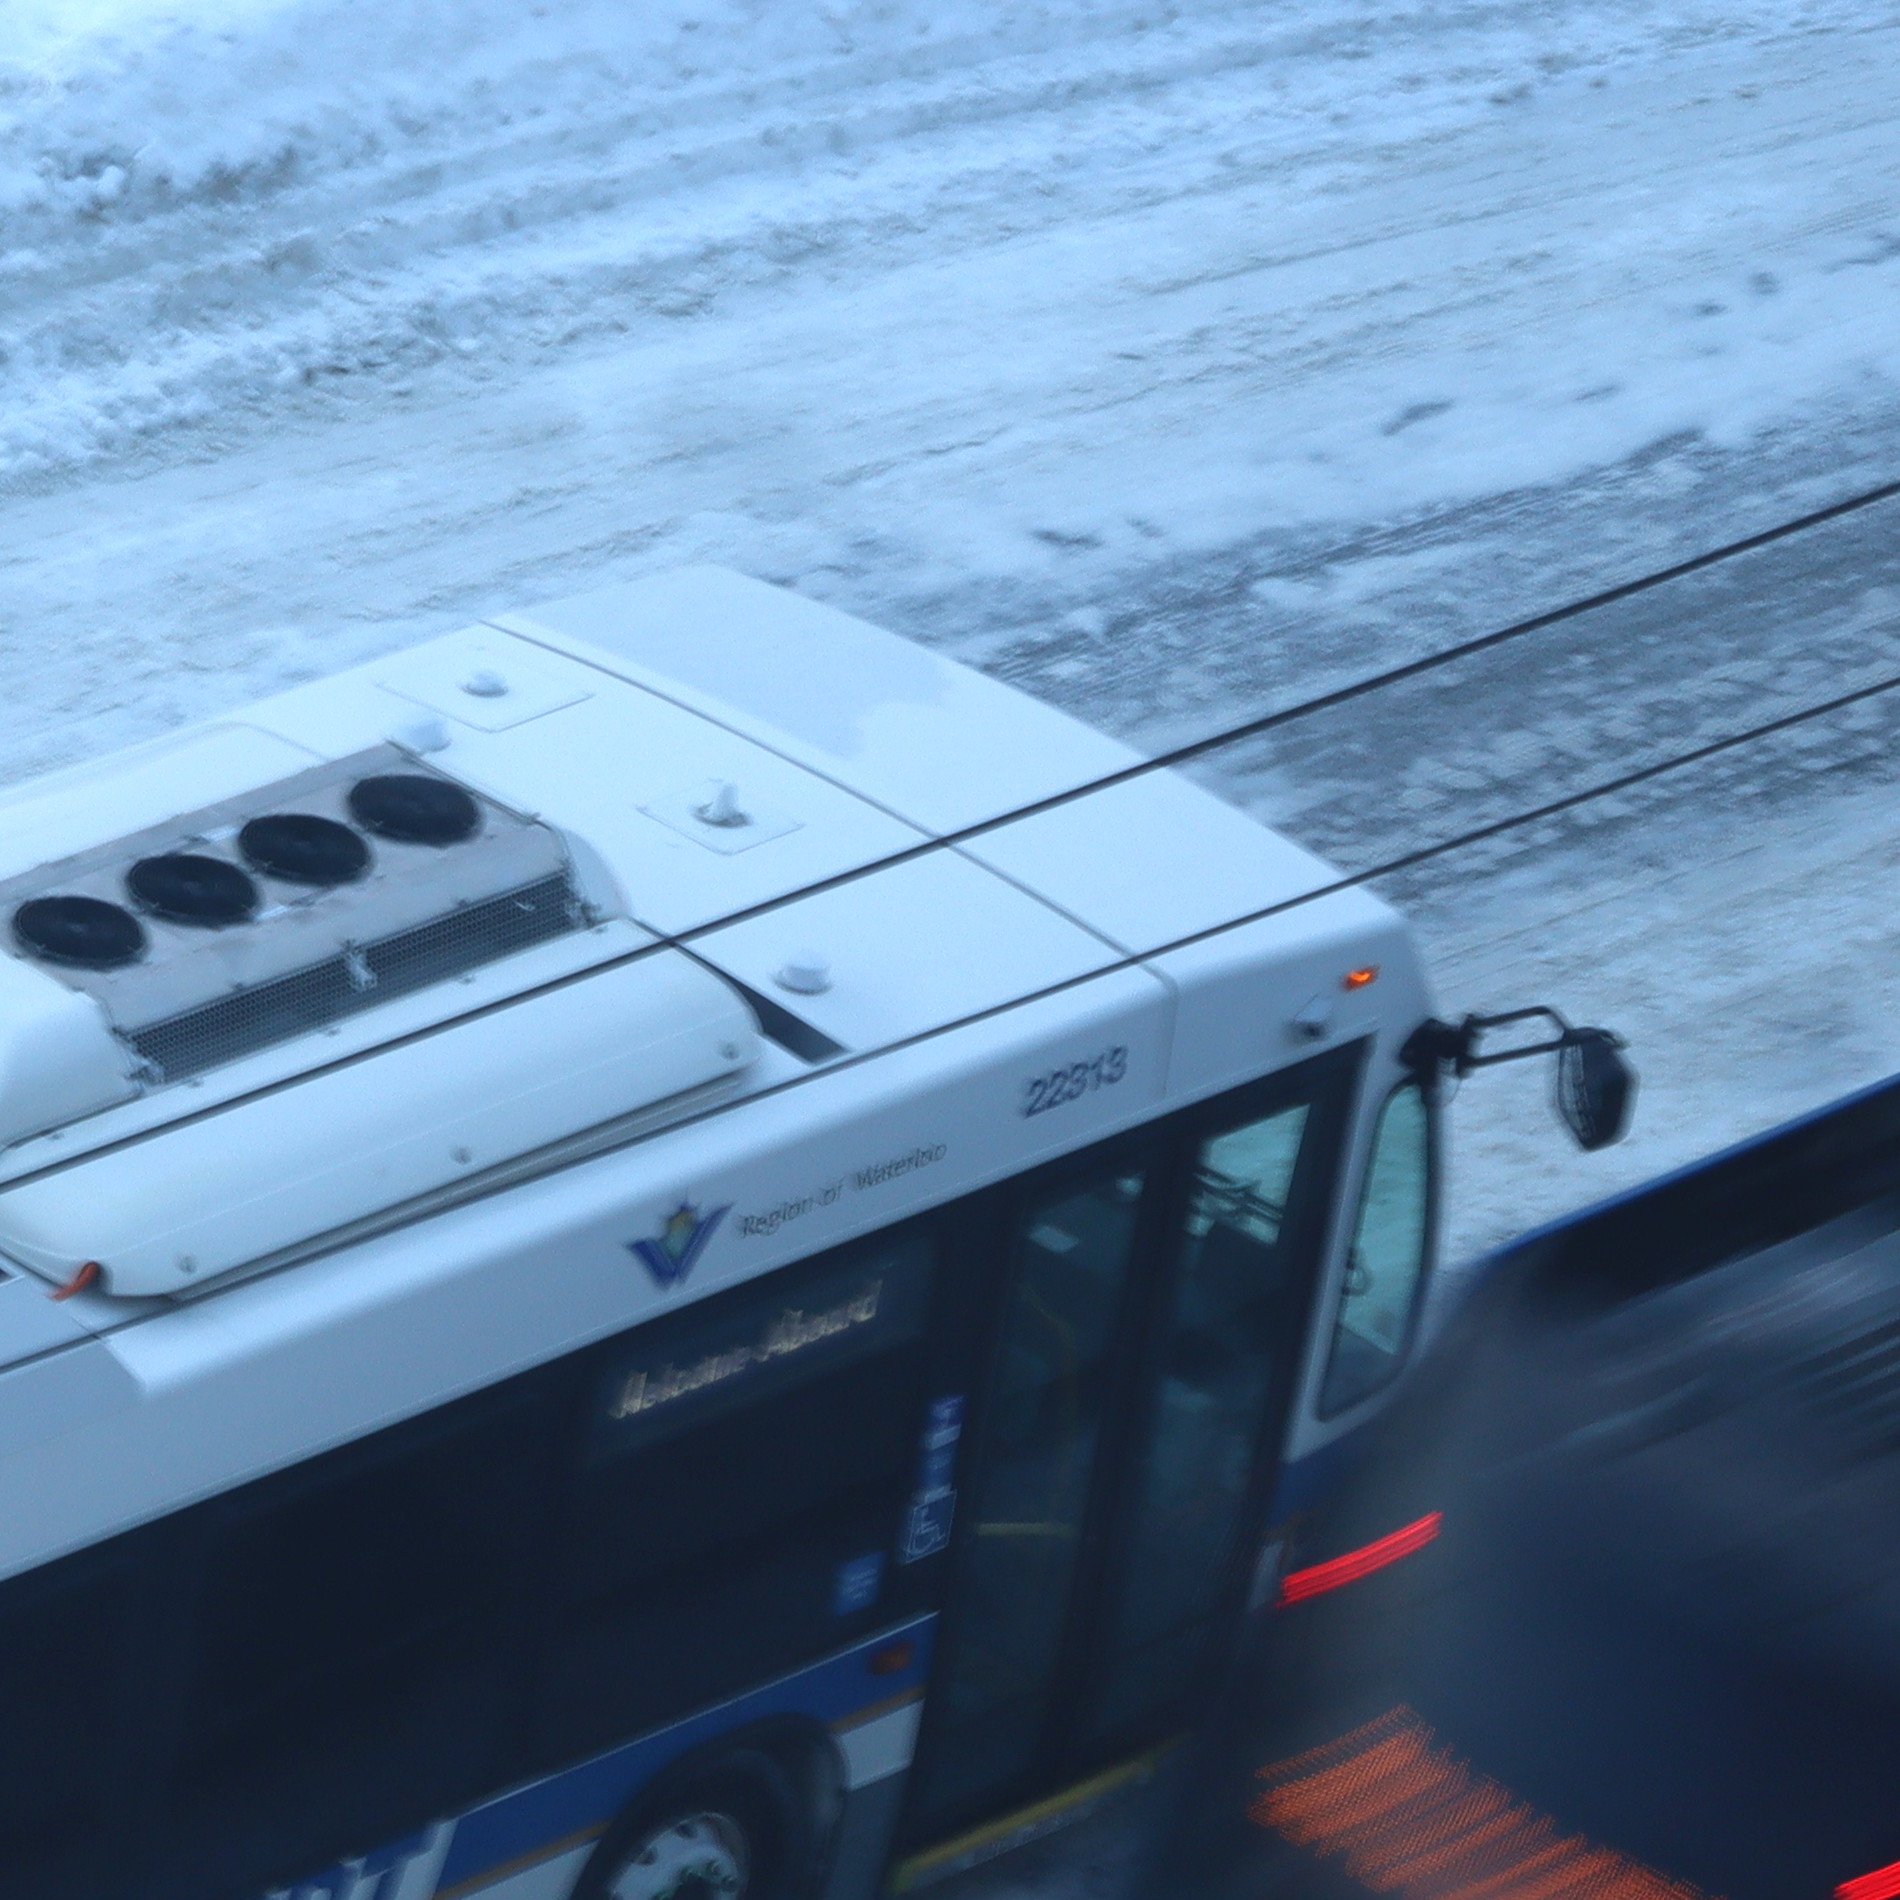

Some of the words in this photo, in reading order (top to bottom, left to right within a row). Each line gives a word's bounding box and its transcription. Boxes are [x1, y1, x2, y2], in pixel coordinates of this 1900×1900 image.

[1022, 1046, 1128, 1118] 22313
[740, 1194, 814, 1238] Region
[818, 1175, 846, 1207] of
[852, 1142, 948, 1191] Waterloo
